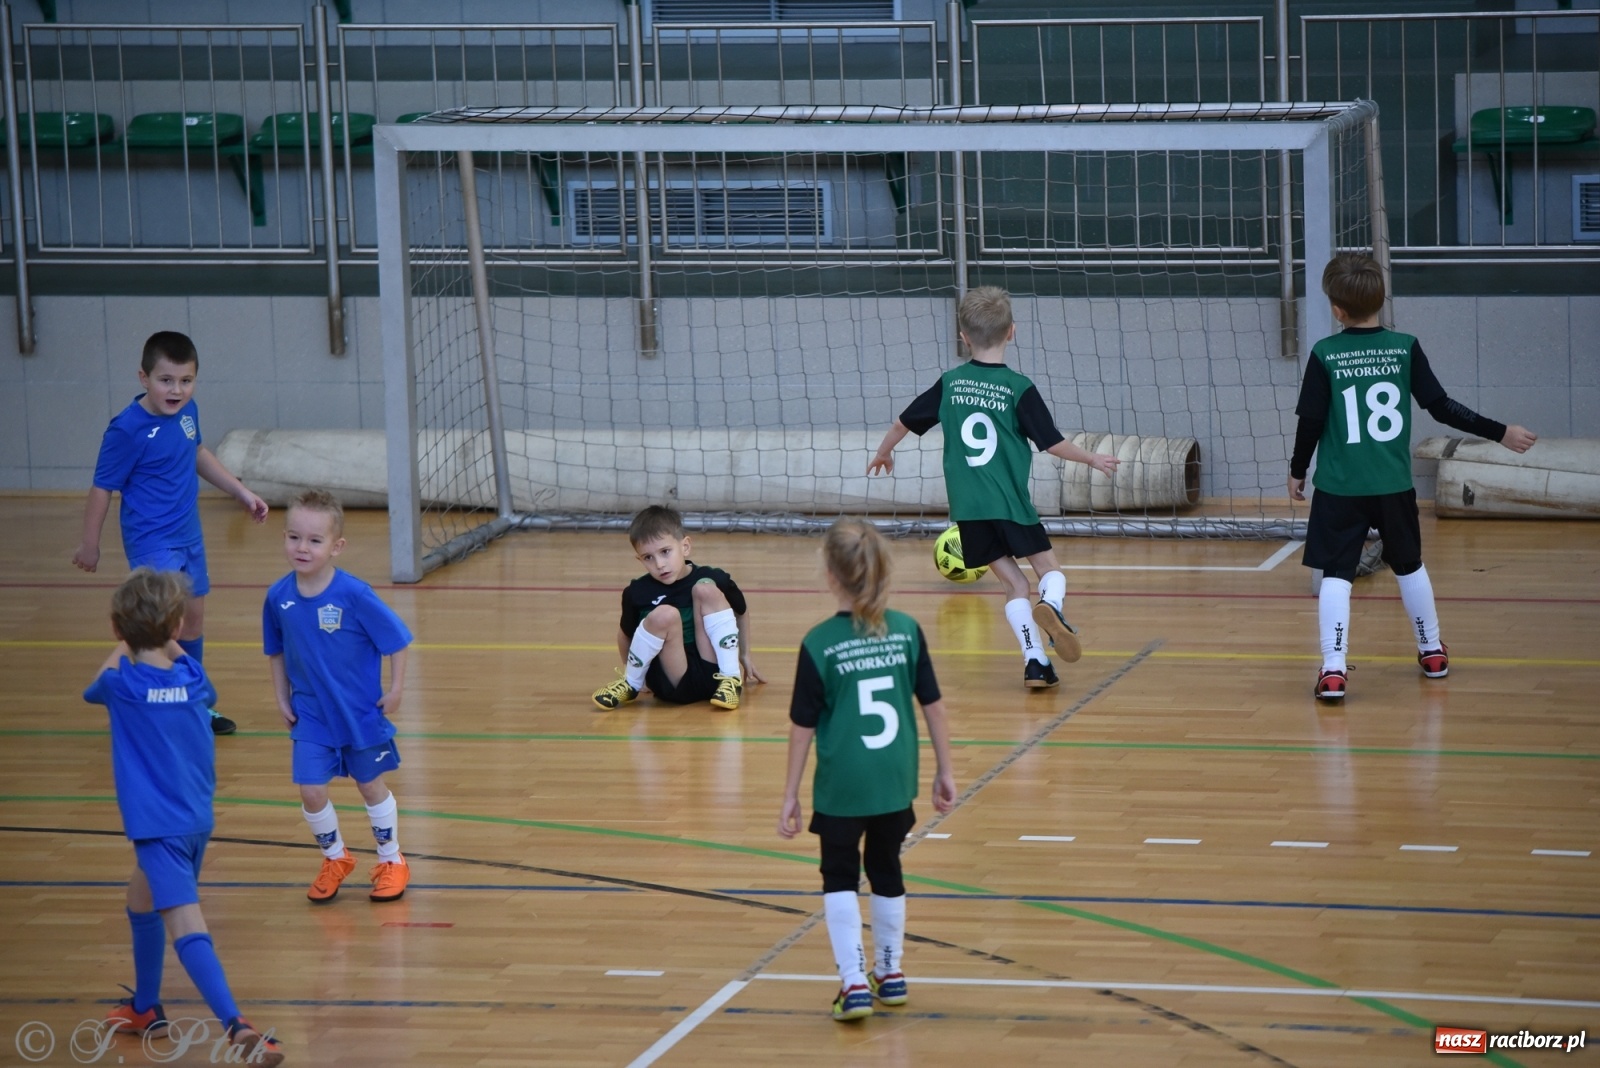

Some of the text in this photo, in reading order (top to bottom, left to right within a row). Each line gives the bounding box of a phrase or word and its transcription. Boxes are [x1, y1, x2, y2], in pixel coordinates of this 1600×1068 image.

[1325, 348, 1408, 361] AKADEMIA PIŁKARSKA
[1337, 357, 1376, 367] MŁODEGO
[1333, 363, 1402, 379] TWORKÓW
[949, 379, 979, 387] AKADEMIA
[950, 395, 1009, 412] TWORKÓW
[1341, 381, 1404, 444] 18
[960, 412, 998, 467] 9
[835, 650, 907, 675] TWORKÓW
[857, 675, 900, 750] 5
